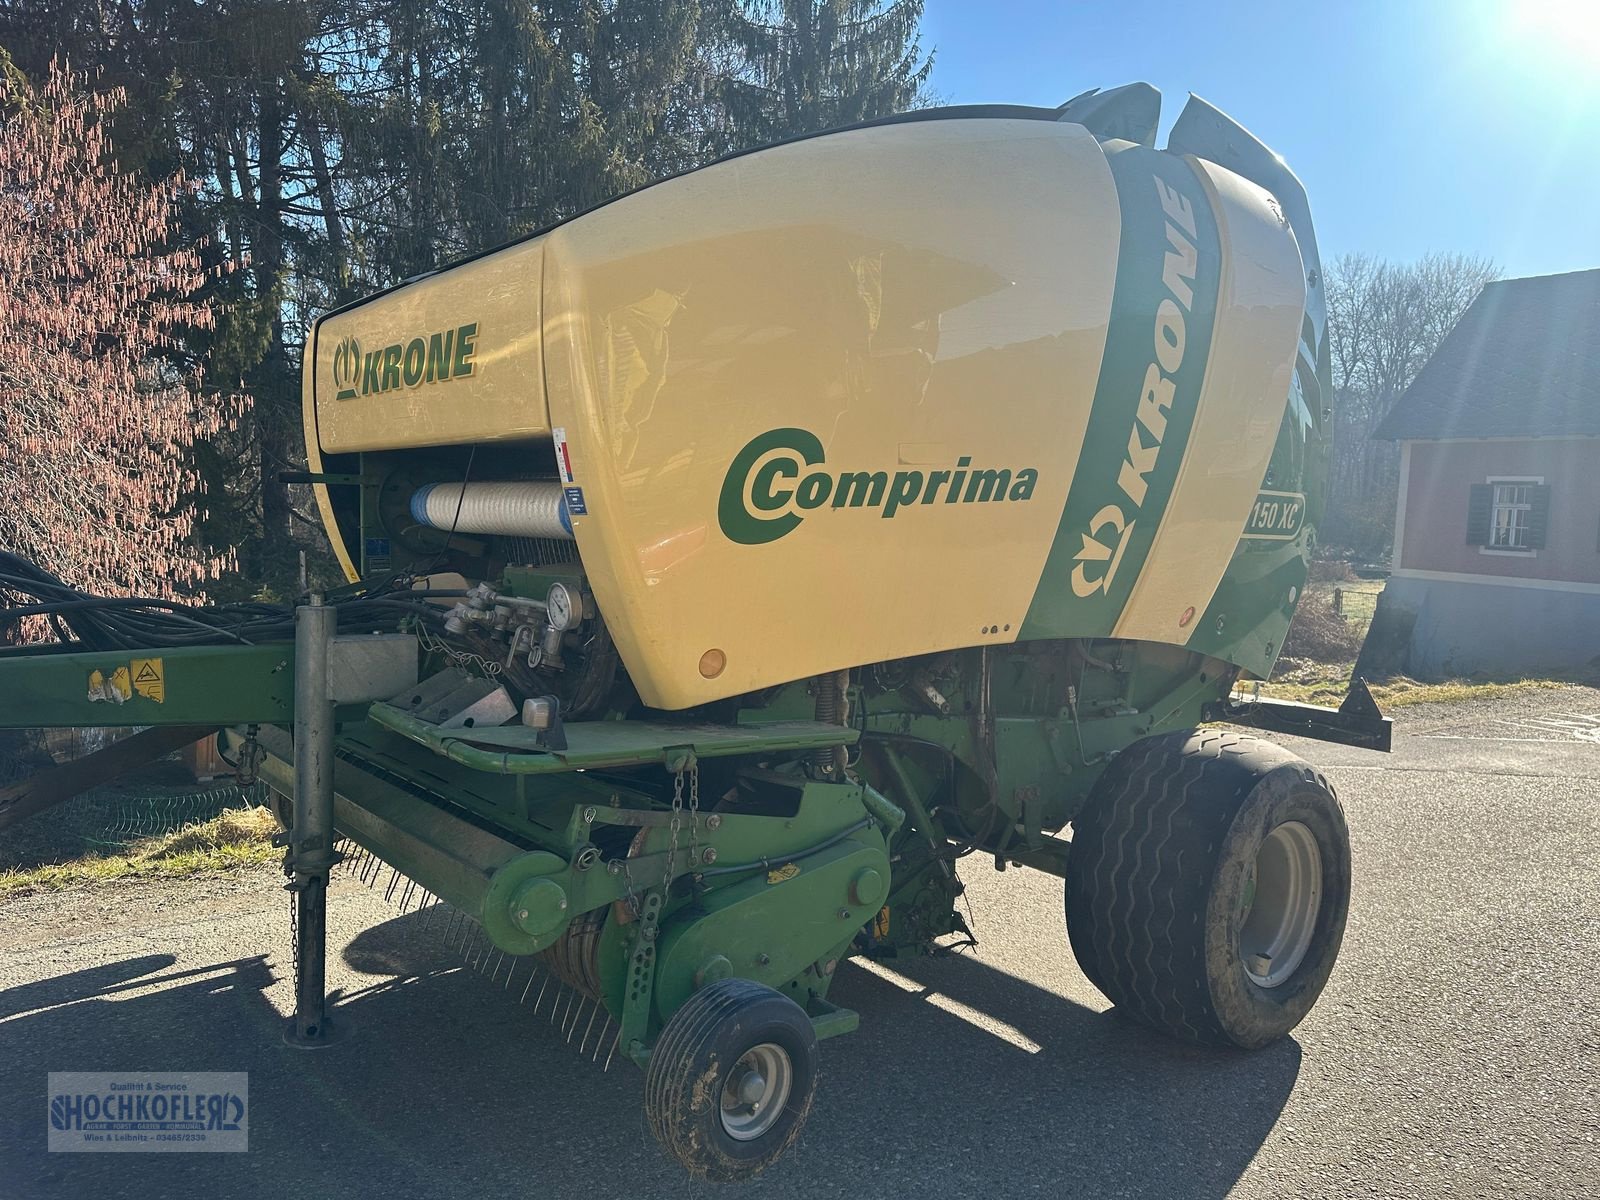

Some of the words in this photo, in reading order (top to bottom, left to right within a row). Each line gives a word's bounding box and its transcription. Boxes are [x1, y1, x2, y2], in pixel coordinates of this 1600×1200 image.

[362, 322, 479, 395] KRONE
[1117, 174, 1198, 508] KRONE
[1251, 502, 1278, 528] 150
[1277, 503, 1299, 529] XC
